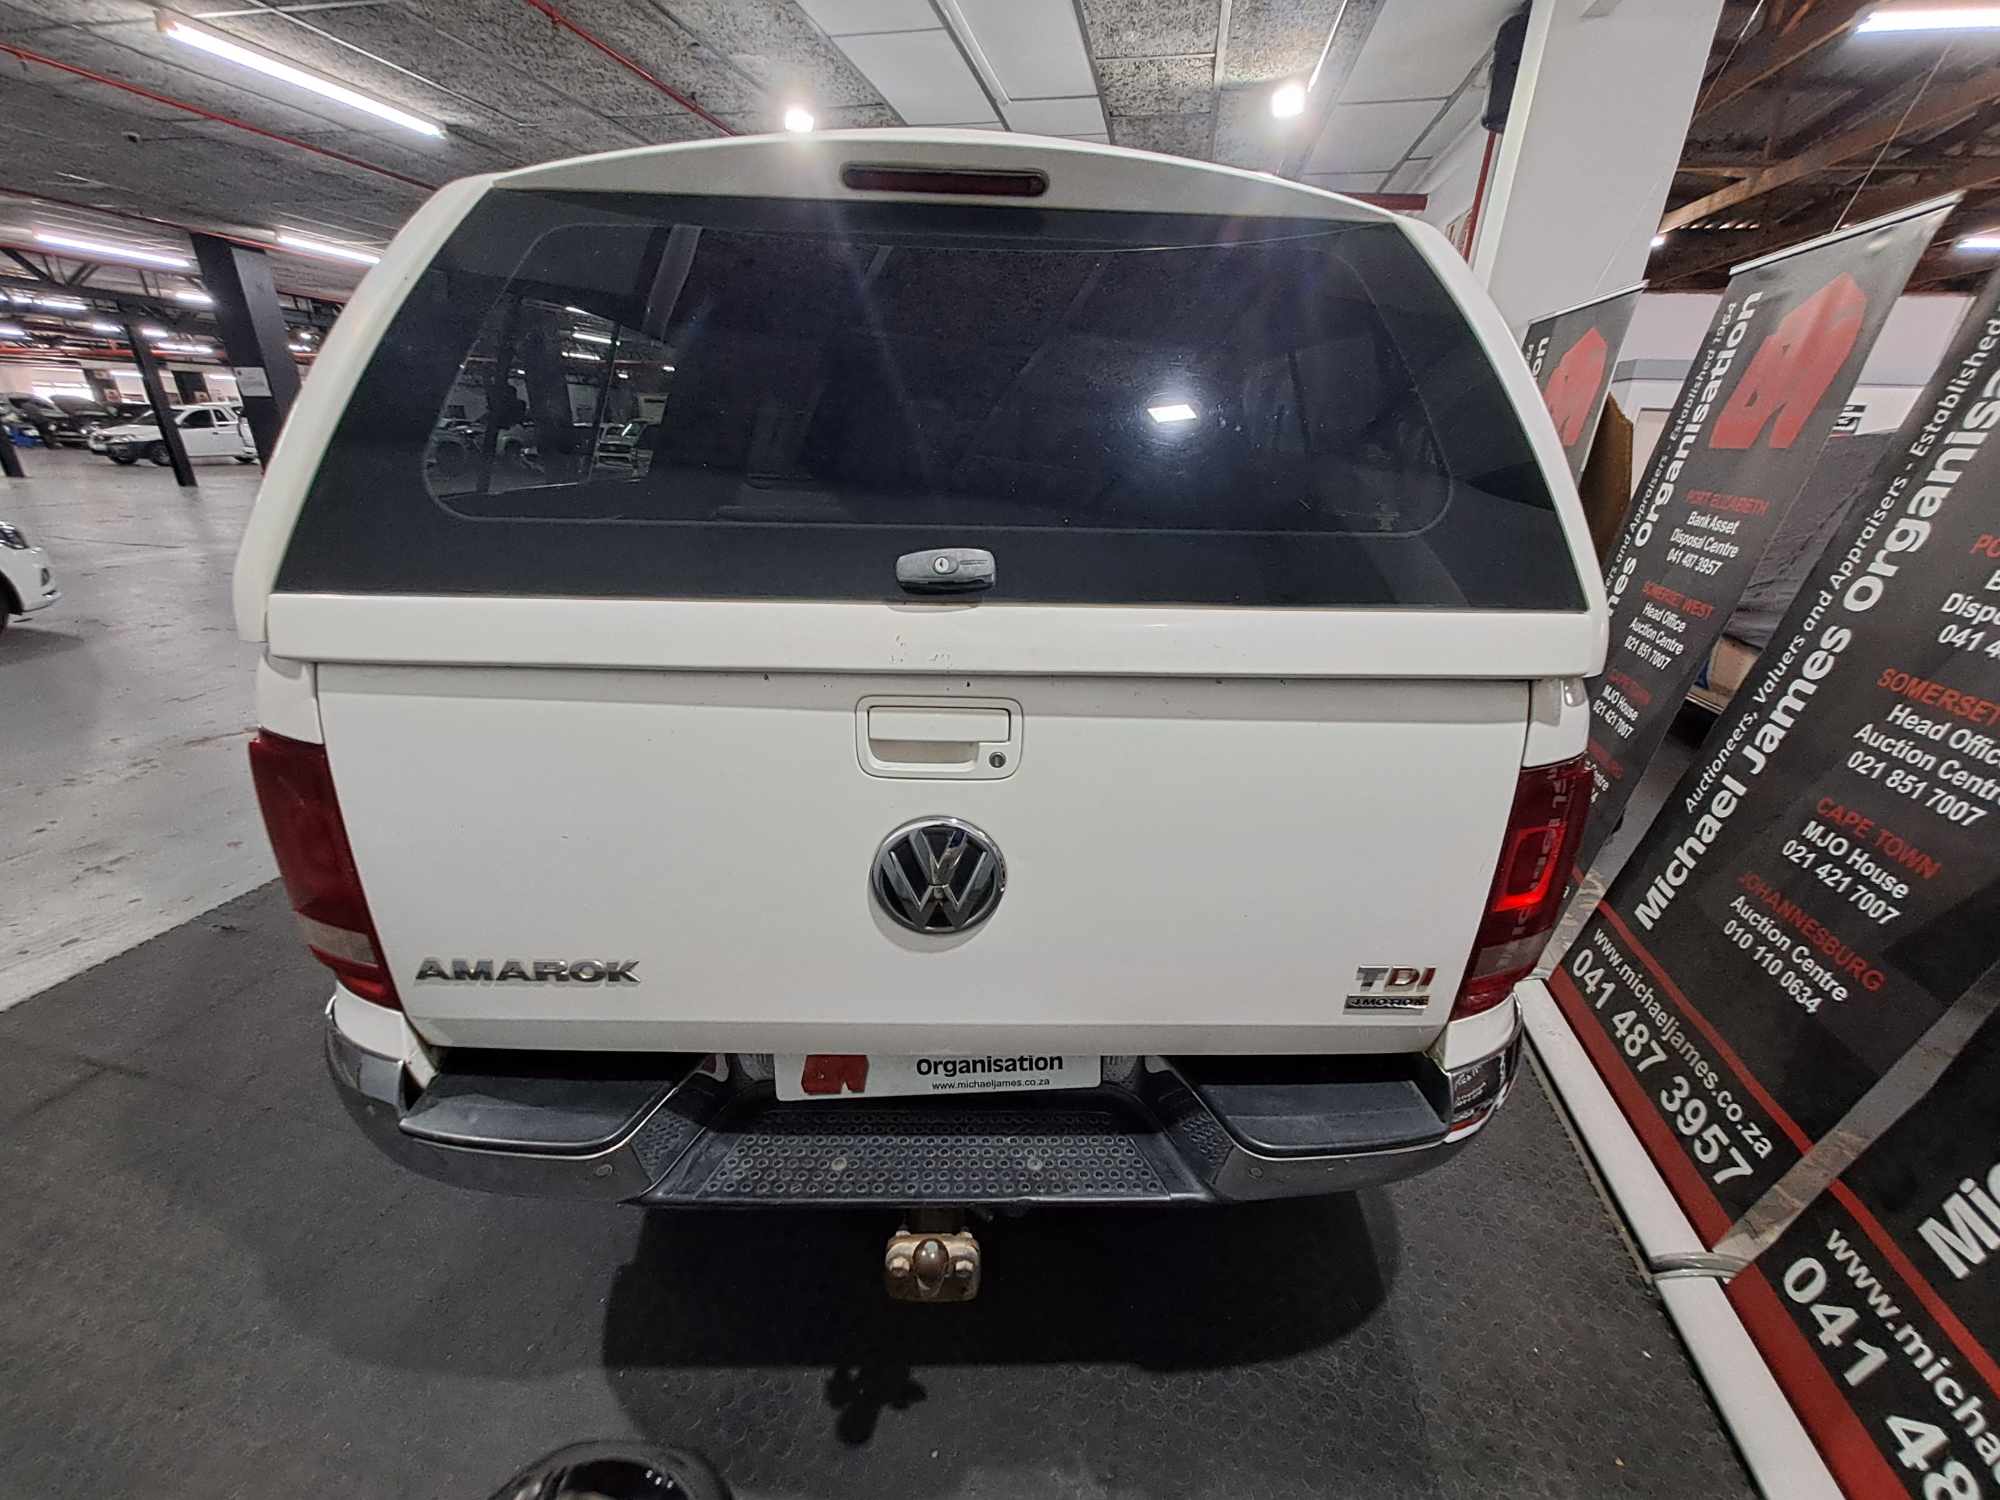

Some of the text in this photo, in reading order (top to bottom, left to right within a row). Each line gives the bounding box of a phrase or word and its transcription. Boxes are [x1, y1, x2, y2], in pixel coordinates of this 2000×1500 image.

[1616, 535, 1632, 563] and
[1630, 455, 1669, 531] Appraisers
[1670, 350, 1716, 442] Established
[1635, 292, 1763, 547] Organisation
[1670, 528, 1739, 558] Disposal Centre
[1686, 511, 1740, 535] Bank Asset
[1685, 711, 1759, 814] Auctioneers,
[1752, 635, 1807, 704] Valuers
[1803, 590, 1833, 632] and
[1829, 476, 1908, 590] Appraisers
[1910, 319, 2000, 457] Established
[1624, 635, 1639, 651] 021
[1649, 650, 1672, 670] 7007
[1629, 617, 1684, 655] Auction Centre
[1642, 602, 1686, 633] Head Office
[1938, 624, 1986, 652] 041
[1602, 684, 1619, 704] MJO
[1617, 694, 1639, 722] House
[1886, 703, 2000, 768] Head Offic
[1633, 774, 1748, 931] Michael
[1742, 626, 1852, 775] James
[1847, 751, 1988, 826] 021 851 7007
[1853, 723, 2000, 806] Auction Centr
[1800, 820, 1909, 899] MJO House
[1816, 796, 1943, 880] CAPE TOWN
[1782, 839, 1901, 925] 021 421 7007
[415, 958, 641, 984] AMAROK
[1356, 965, 1437, 989] TDI
[1723, 919, 1823, 1014] 010 110 0634
[1730, 895, 1849, 1002] Auction Centre
[916, 1055, 1063, 1077] Organisation
[1572, 947, 1754, 1185] 041 487 3957
[1593, 927, 1774, 1160] www.michaeljames.co.za
[932, 1078, 1050, 1091] www.michaeljames.co.za
[1783, 1256, 1890, 1388] 041
[1825, 1228, 2000, 1484] www.micha
